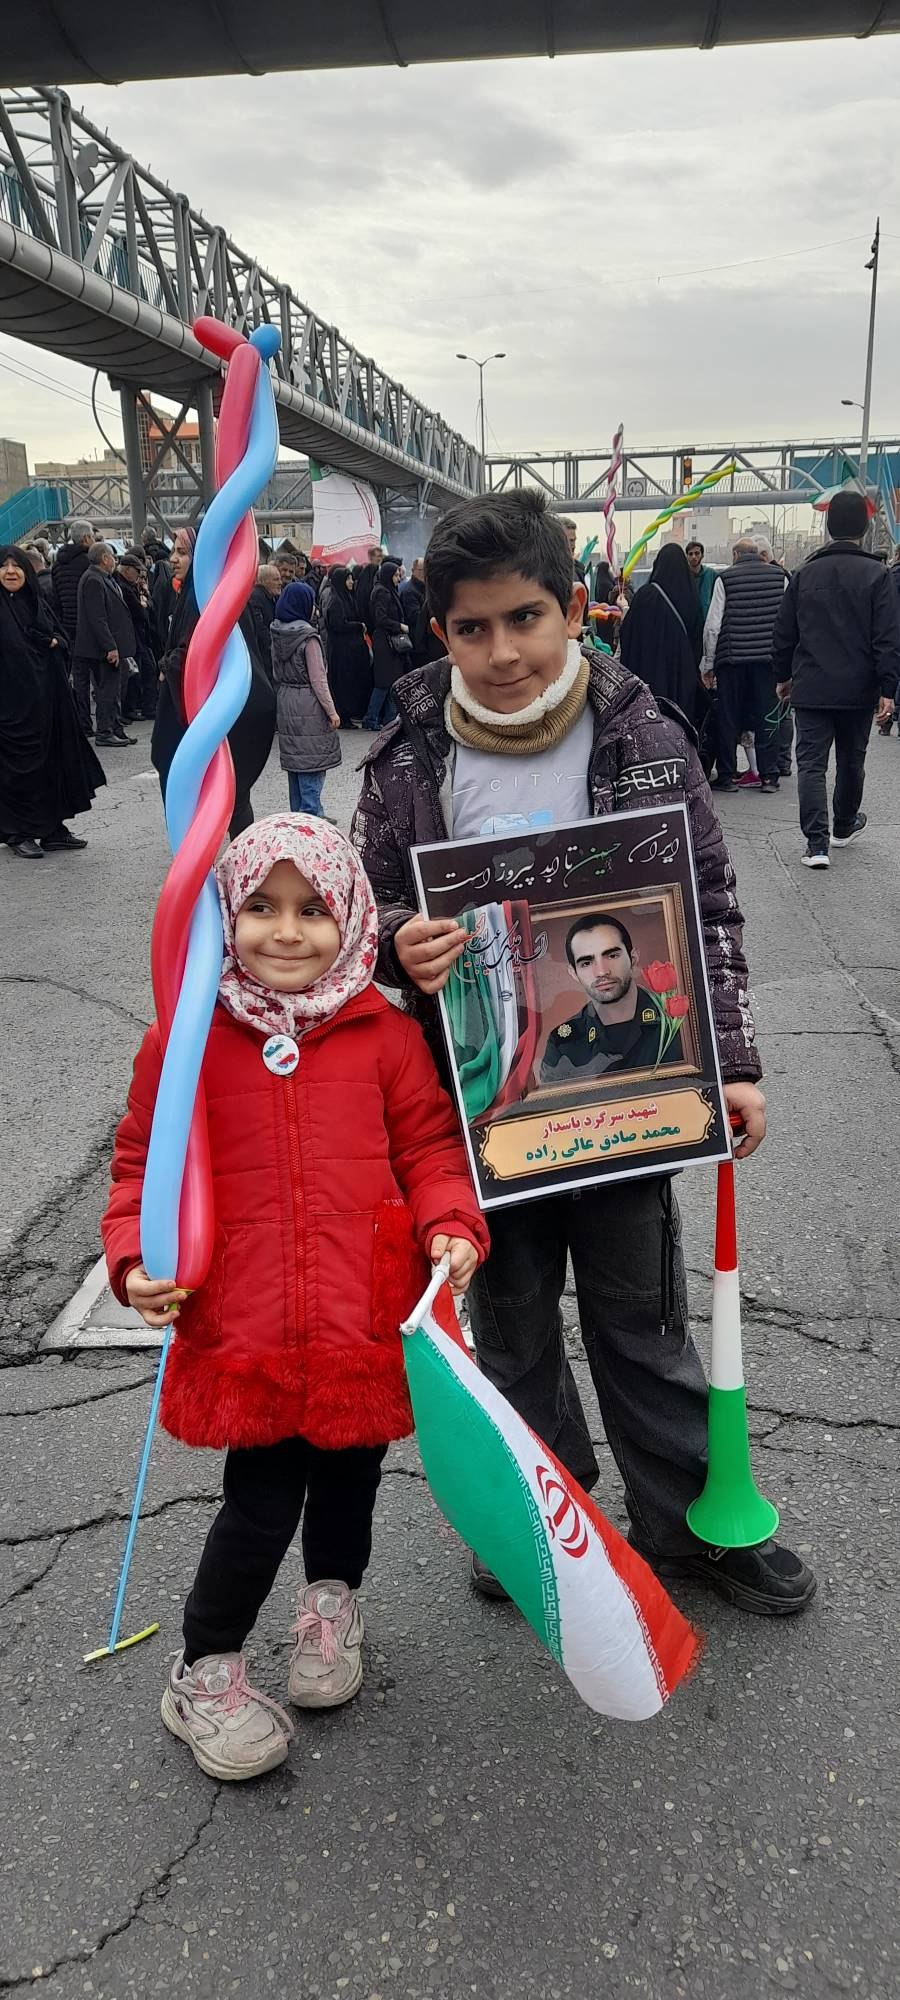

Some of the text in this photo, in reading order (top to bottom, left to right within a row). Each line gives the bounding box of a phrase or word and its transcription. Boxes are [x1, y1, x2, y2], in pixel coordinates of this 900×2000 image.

[490, 772, 563, 792] CITY
[628, 823, 680, 863] ایران
[540, 856, 560, 883] ابد
[563, 842, 622, 888] حسین
[564, 845, 578, 870] تا
[427, 867, 491, 892] است
[495, 862, 535, 889] پیروز
[627, 1102, 658, 1120] شهید
[542, 1115, 581, 1139] پاسدار
[526, 1124, 681, 1161] محمد صادق عالی زاده
